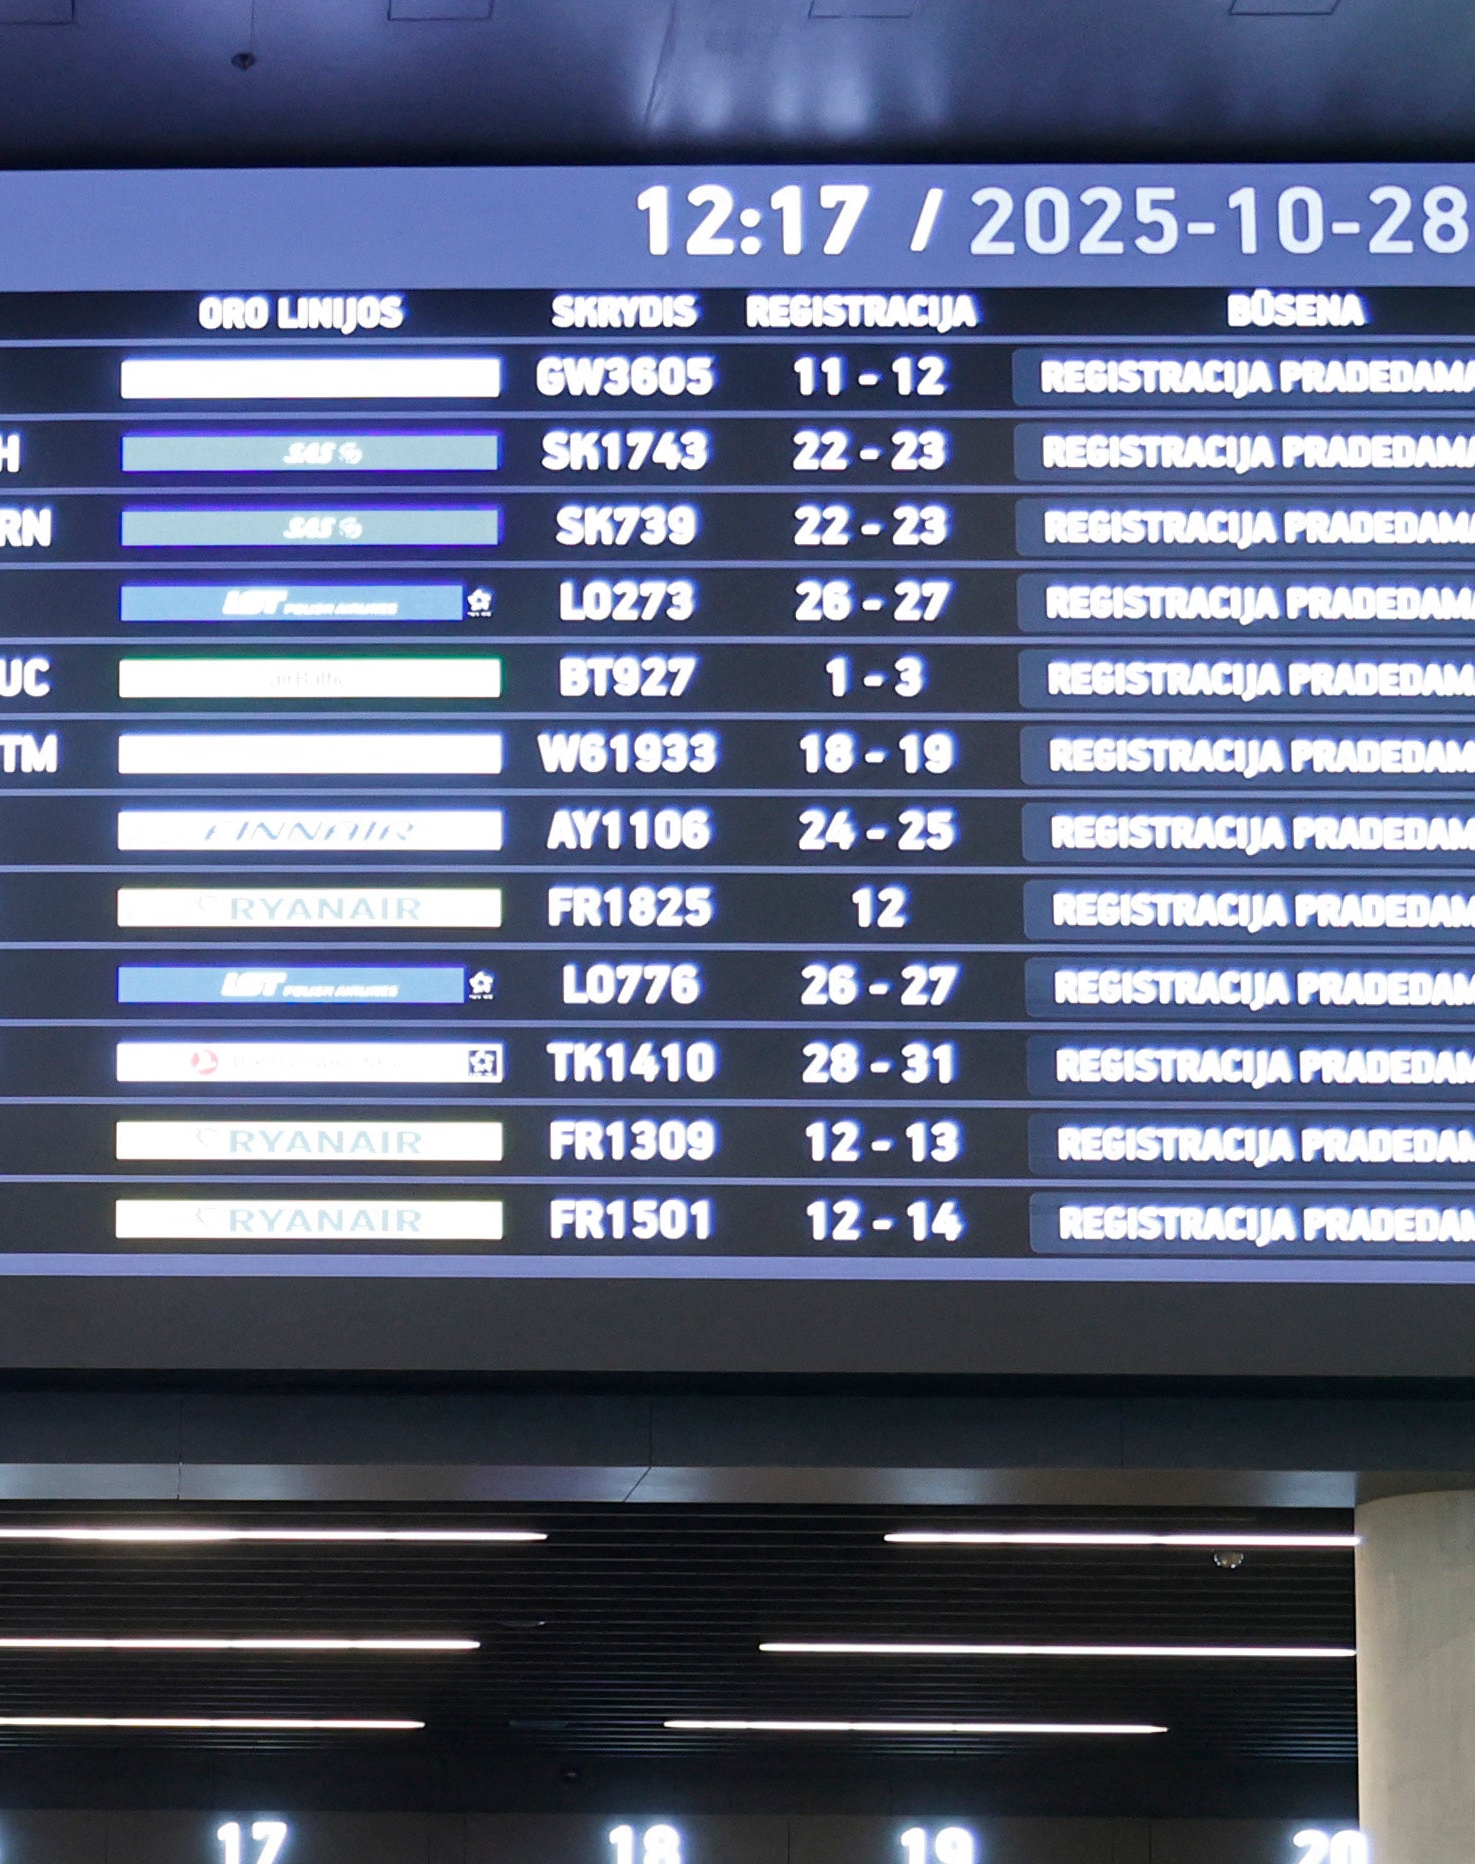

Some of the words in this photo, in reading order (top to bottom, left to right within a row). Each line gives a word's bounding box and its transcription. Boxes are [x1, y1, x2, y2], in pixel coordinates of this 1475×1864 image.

[638, 185, 869, 255] 12:17
[910, 188, 943, 251] /
[970, 186, 1469, 256] 2025-10-28
[199, 297, 269, 329] ORO
[278, 296, 403, 334] LINIJOS
[552, 295, 697, 328] SKRYDIS
[746, 294, 977, 333] REGISTRACIJA
[536, 357, 713, 396] GW3605
[542, 431, 707, 470] SK1743
[203, 821, 415, 842] FINNAIR
[547, 810, 710, 849] AY1106
[229, 1129, 422, 1154] RYANAIR
[550, 1121, 714, 1160] FR1309
